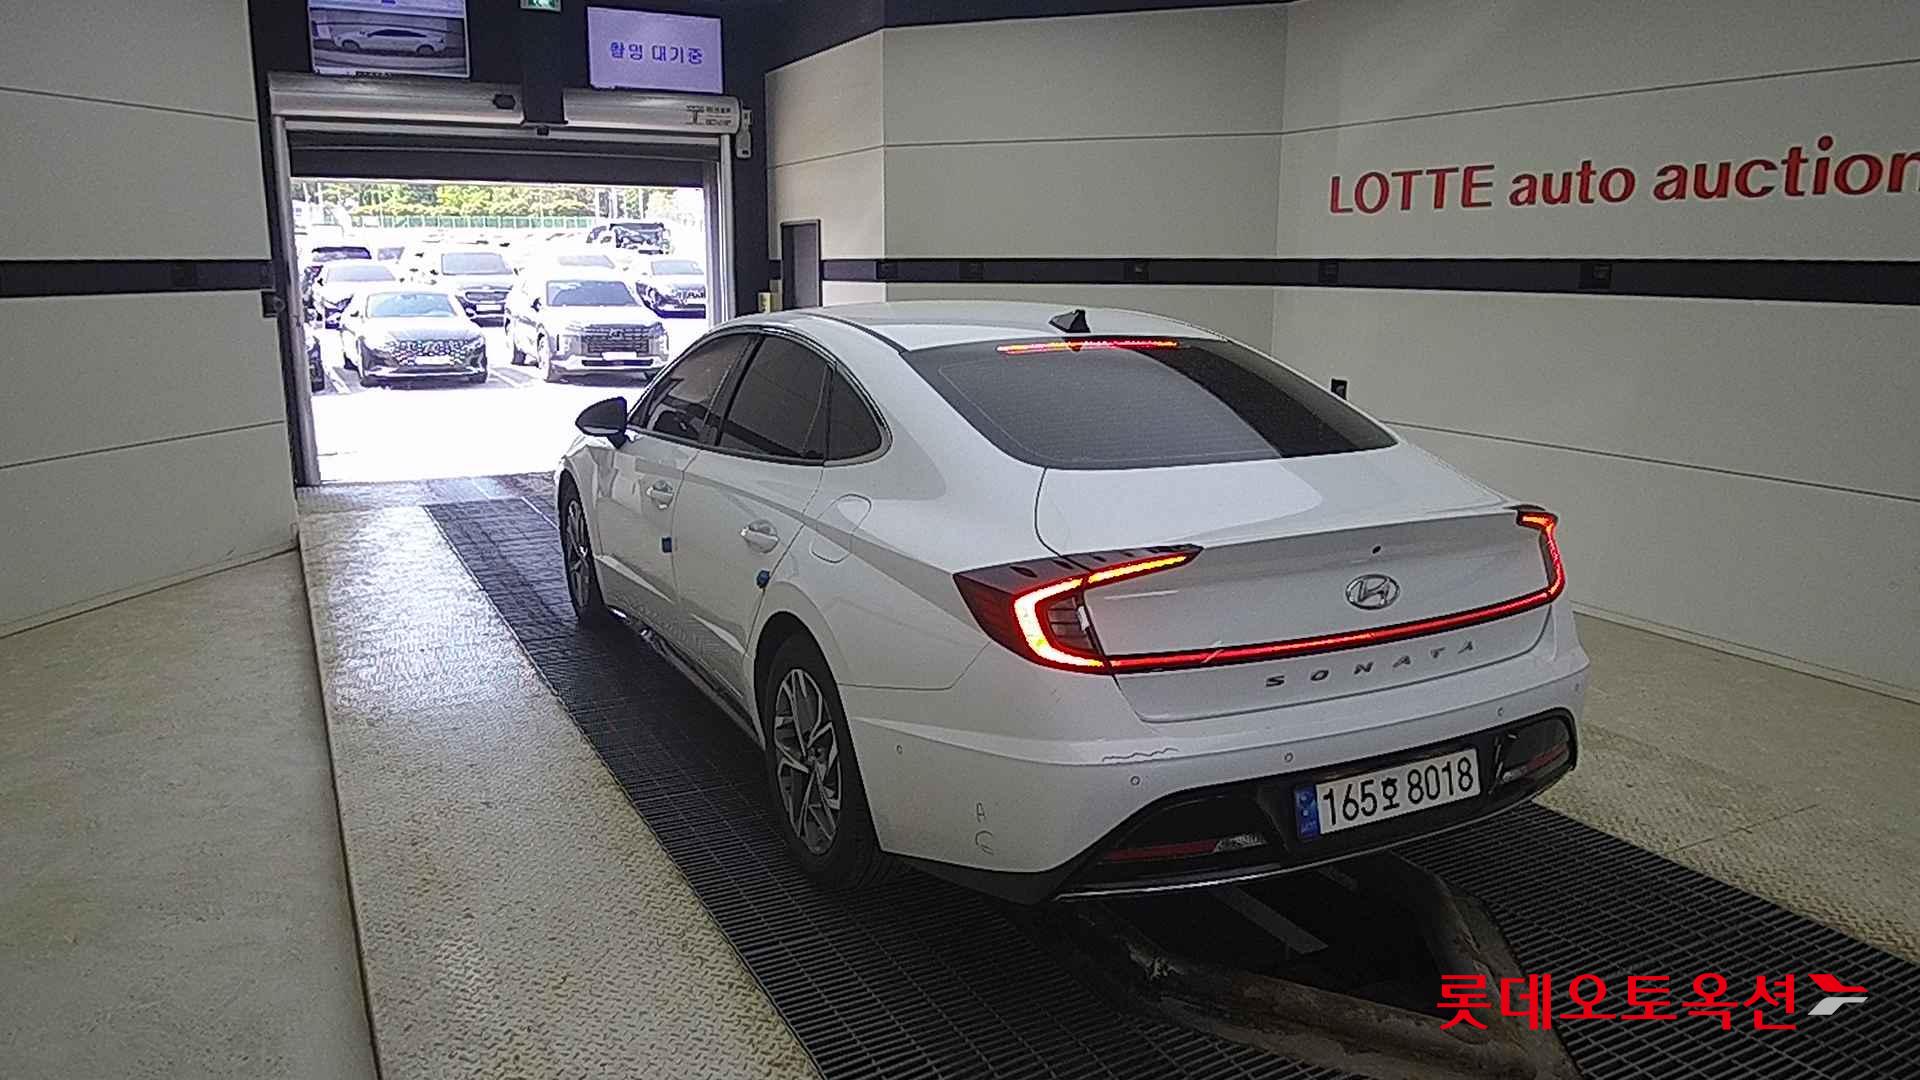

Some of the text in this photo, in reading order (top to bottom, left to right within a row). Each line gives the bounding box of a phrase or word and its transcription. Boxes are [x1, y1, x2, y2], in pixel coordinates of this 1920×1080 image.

[651, 45, 703, 65] 대기중
[1330, 164, 1495, 214] LOTTE
[1510, 160, 1636, 206] auto
[1265, 641, 1474, 687] SONATA
